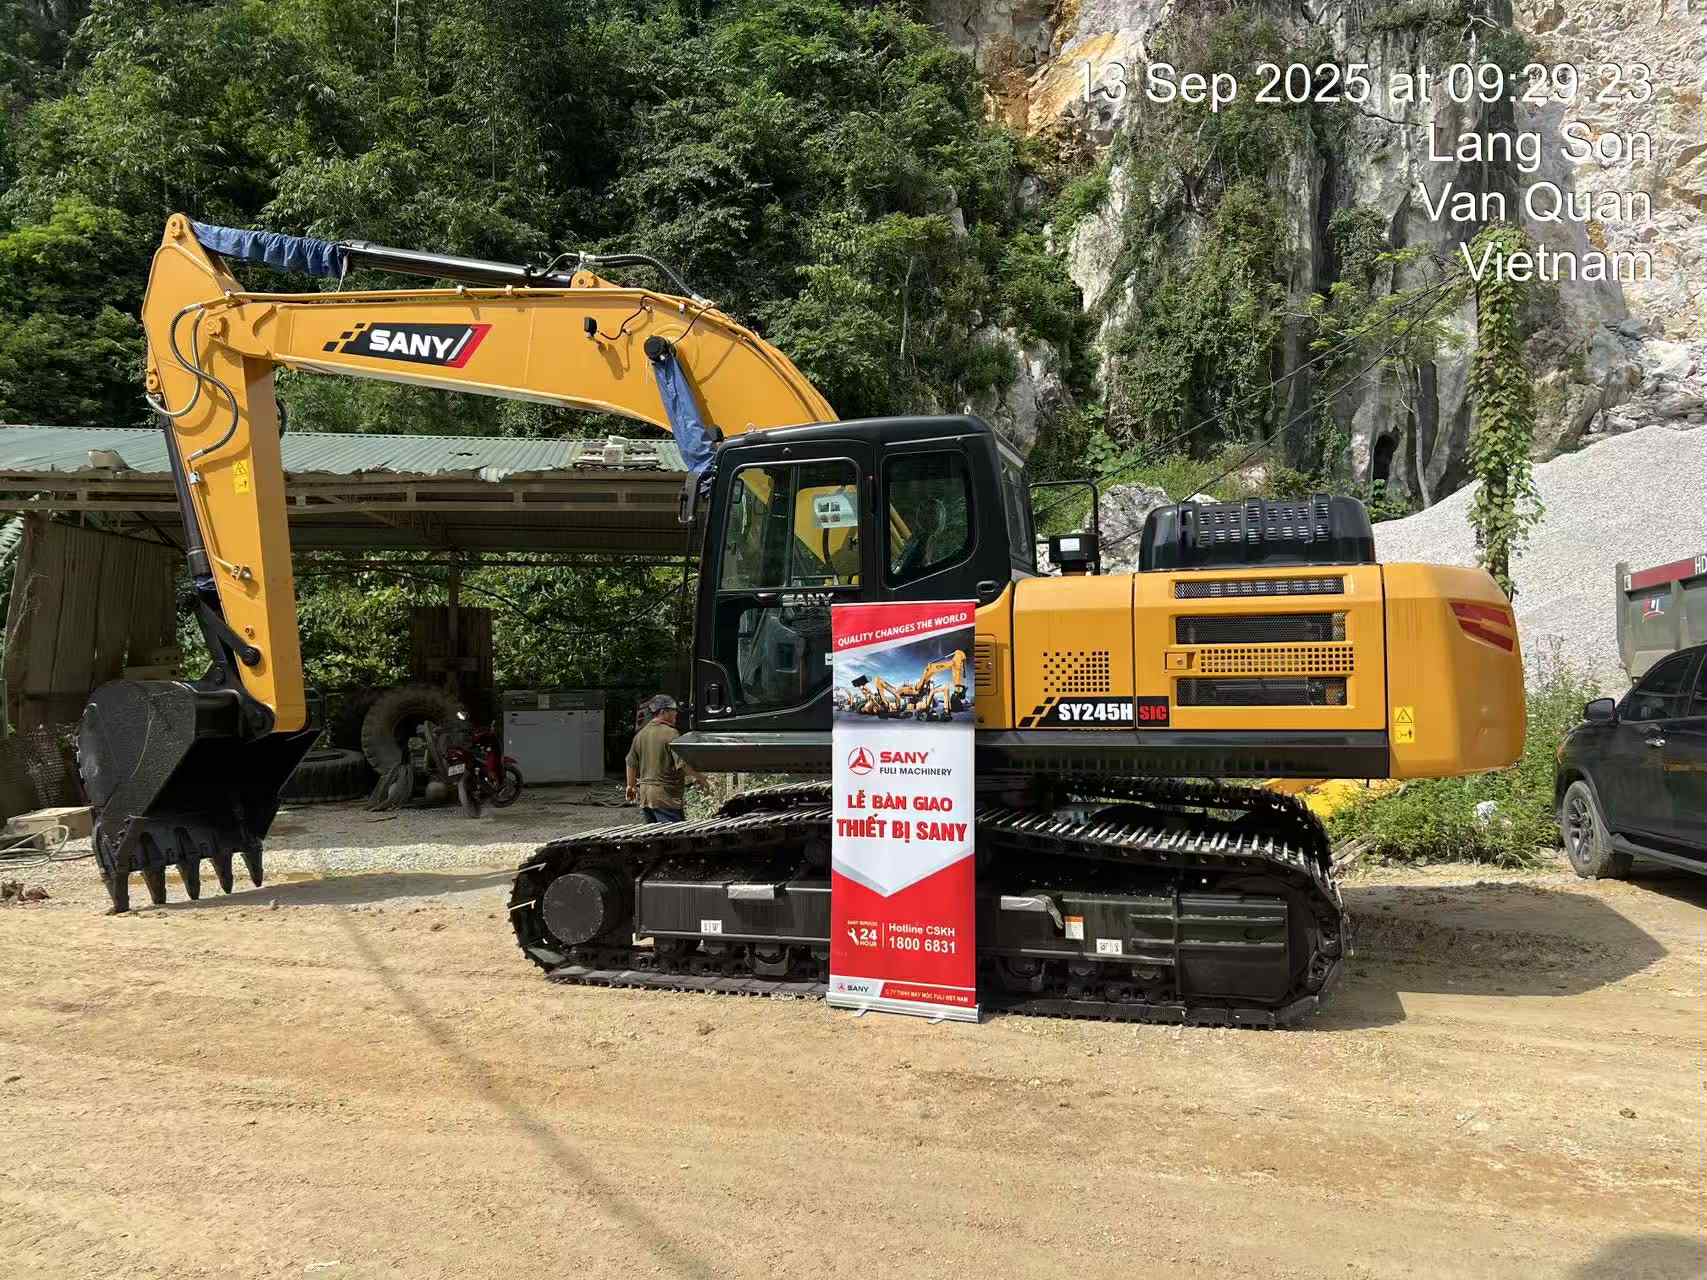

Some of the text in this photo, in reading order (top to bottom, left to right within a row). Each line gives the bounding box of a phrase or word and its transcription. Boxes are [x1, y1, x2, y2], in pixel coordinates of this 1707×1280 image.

[369, 329, 454, 359] SANY
[782, 592, 834, 606] SANY
[838, 612, 967, 647] QUALITY CHANGES THE WORLD
[1058, 703, 1134, 721] SY245H
[880, 751, 929, 764] SANY
[880, 767, 952, 776] FULI MACHINERY
[847, 789, 953, 812] LỄ BÀN GIAO
[836, 813, 968, 844] THIẾT BỊ SANY
[860, 927, 877, 940] 24
[888, 923, 923, 935] Hotline
[926, 925, 956, 937] CSKH
[889, 936, 956, 954] 1800 6831
[847, 984, 869, 993] SANY
